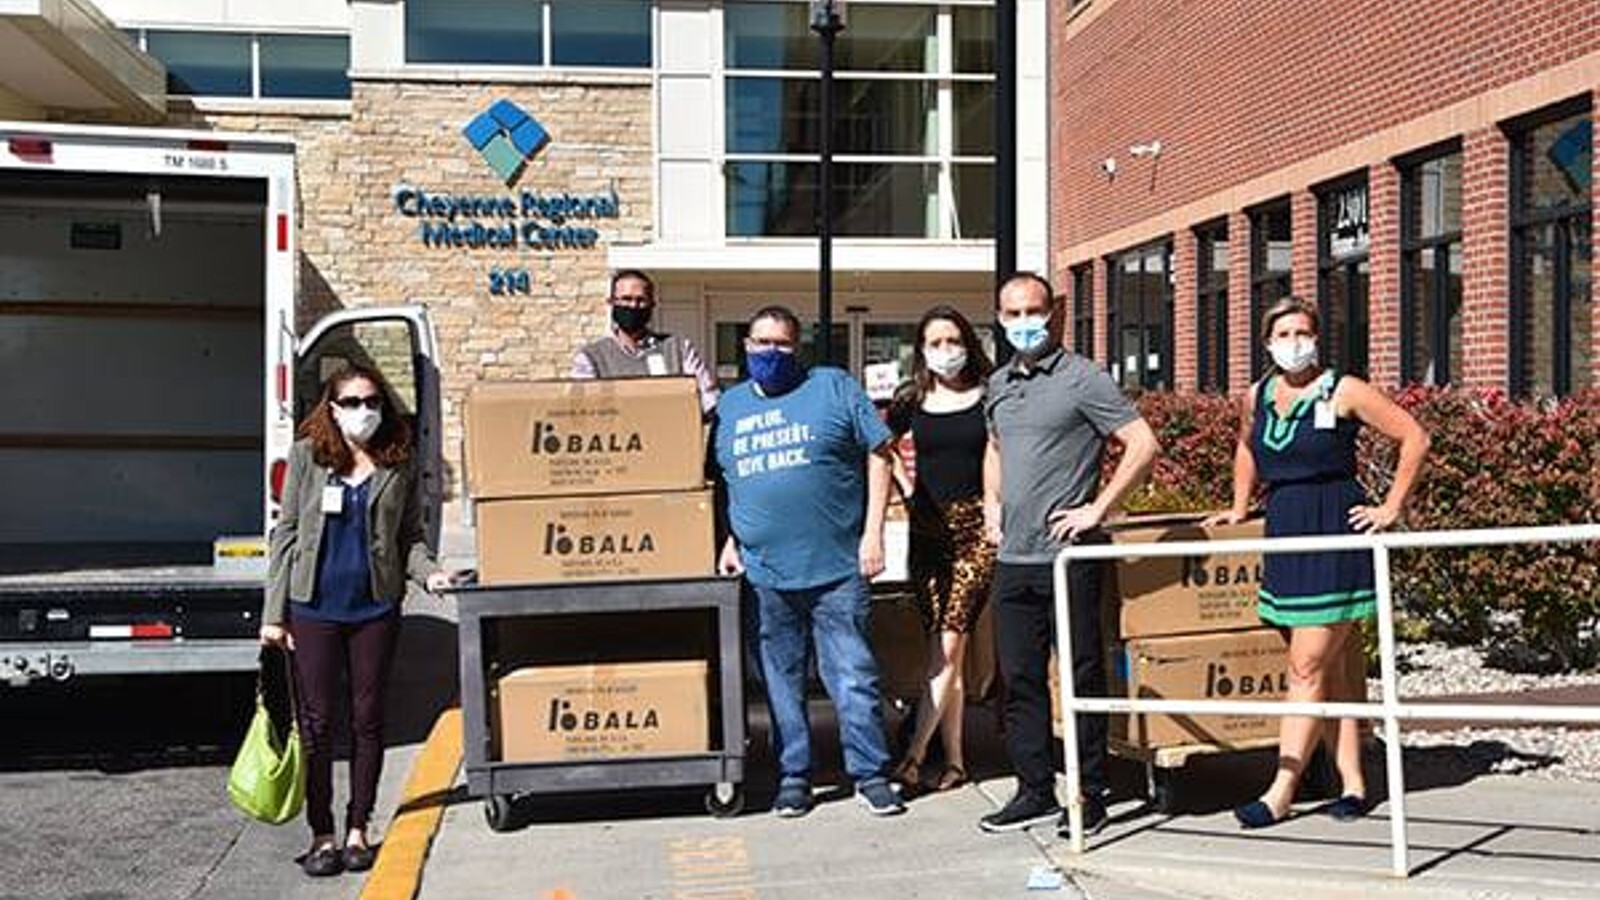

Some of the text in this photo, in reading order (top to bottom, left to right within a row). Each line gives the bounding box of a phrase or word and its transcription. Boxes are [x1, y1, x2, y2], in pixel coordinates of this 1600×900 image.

[395, 182, 619, 225] Cheyenne Regional
[420, 221, 598, 250] Medical Center
[488, 267, 531, 295] 214
[567, 432, 643, 453] BALA
[579, 533, 655, 554] BALA
[1214, 564, 1263, 585] BAL
[583, 709, 660, 730] BALA
